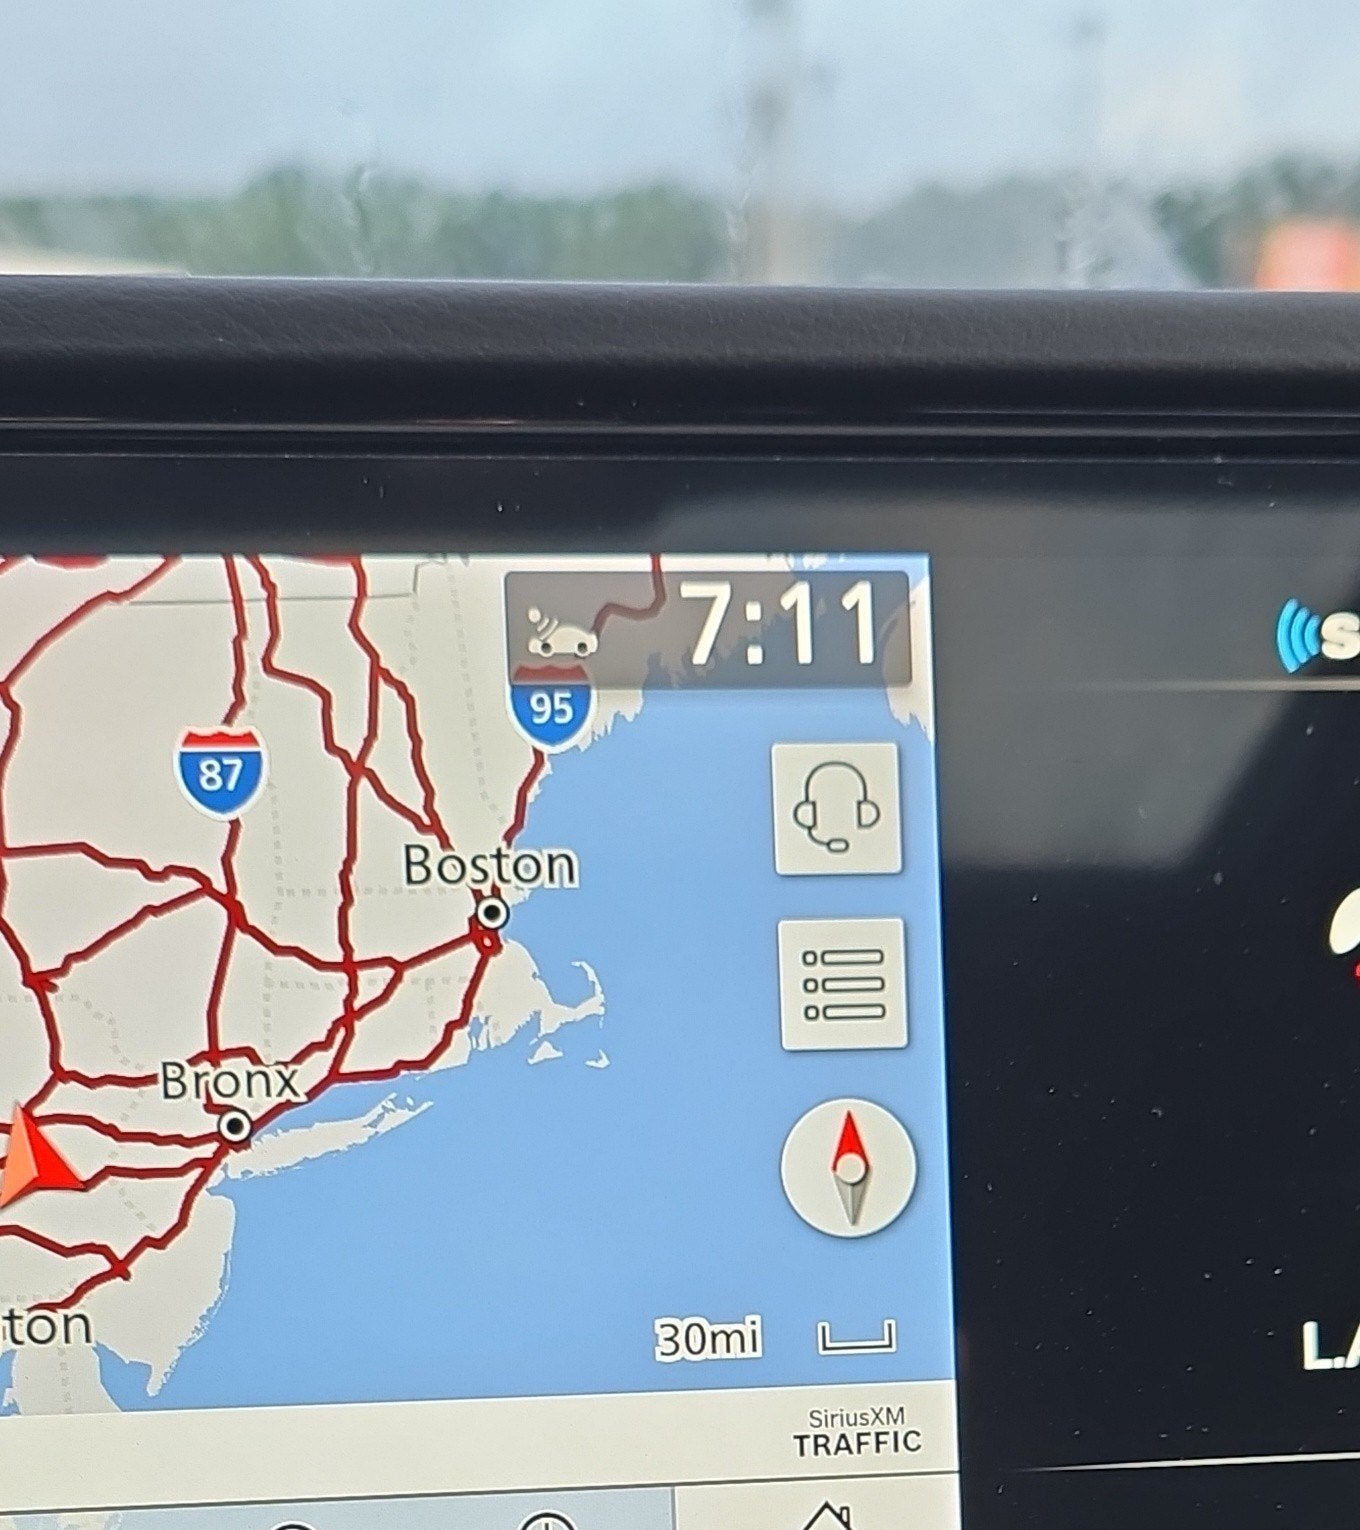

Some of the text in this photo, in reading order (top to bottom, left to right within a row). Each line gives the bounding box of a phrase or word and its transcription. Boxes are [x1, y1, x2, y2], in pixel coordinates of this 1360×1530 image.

[680, 581, 875, 666] 7:11
[529, 691, 574, 724] 95
[199, 758, 243, 792] 87
[403, 844, 578, 886] Boston
[161, 1062, 302, 1101] Bronx
[657, 1318, 760, 1358] 30mi
[809, 1406, 906, 1429] SiriusXM
[793, 1430, 923, 1457] TRAFFIC
